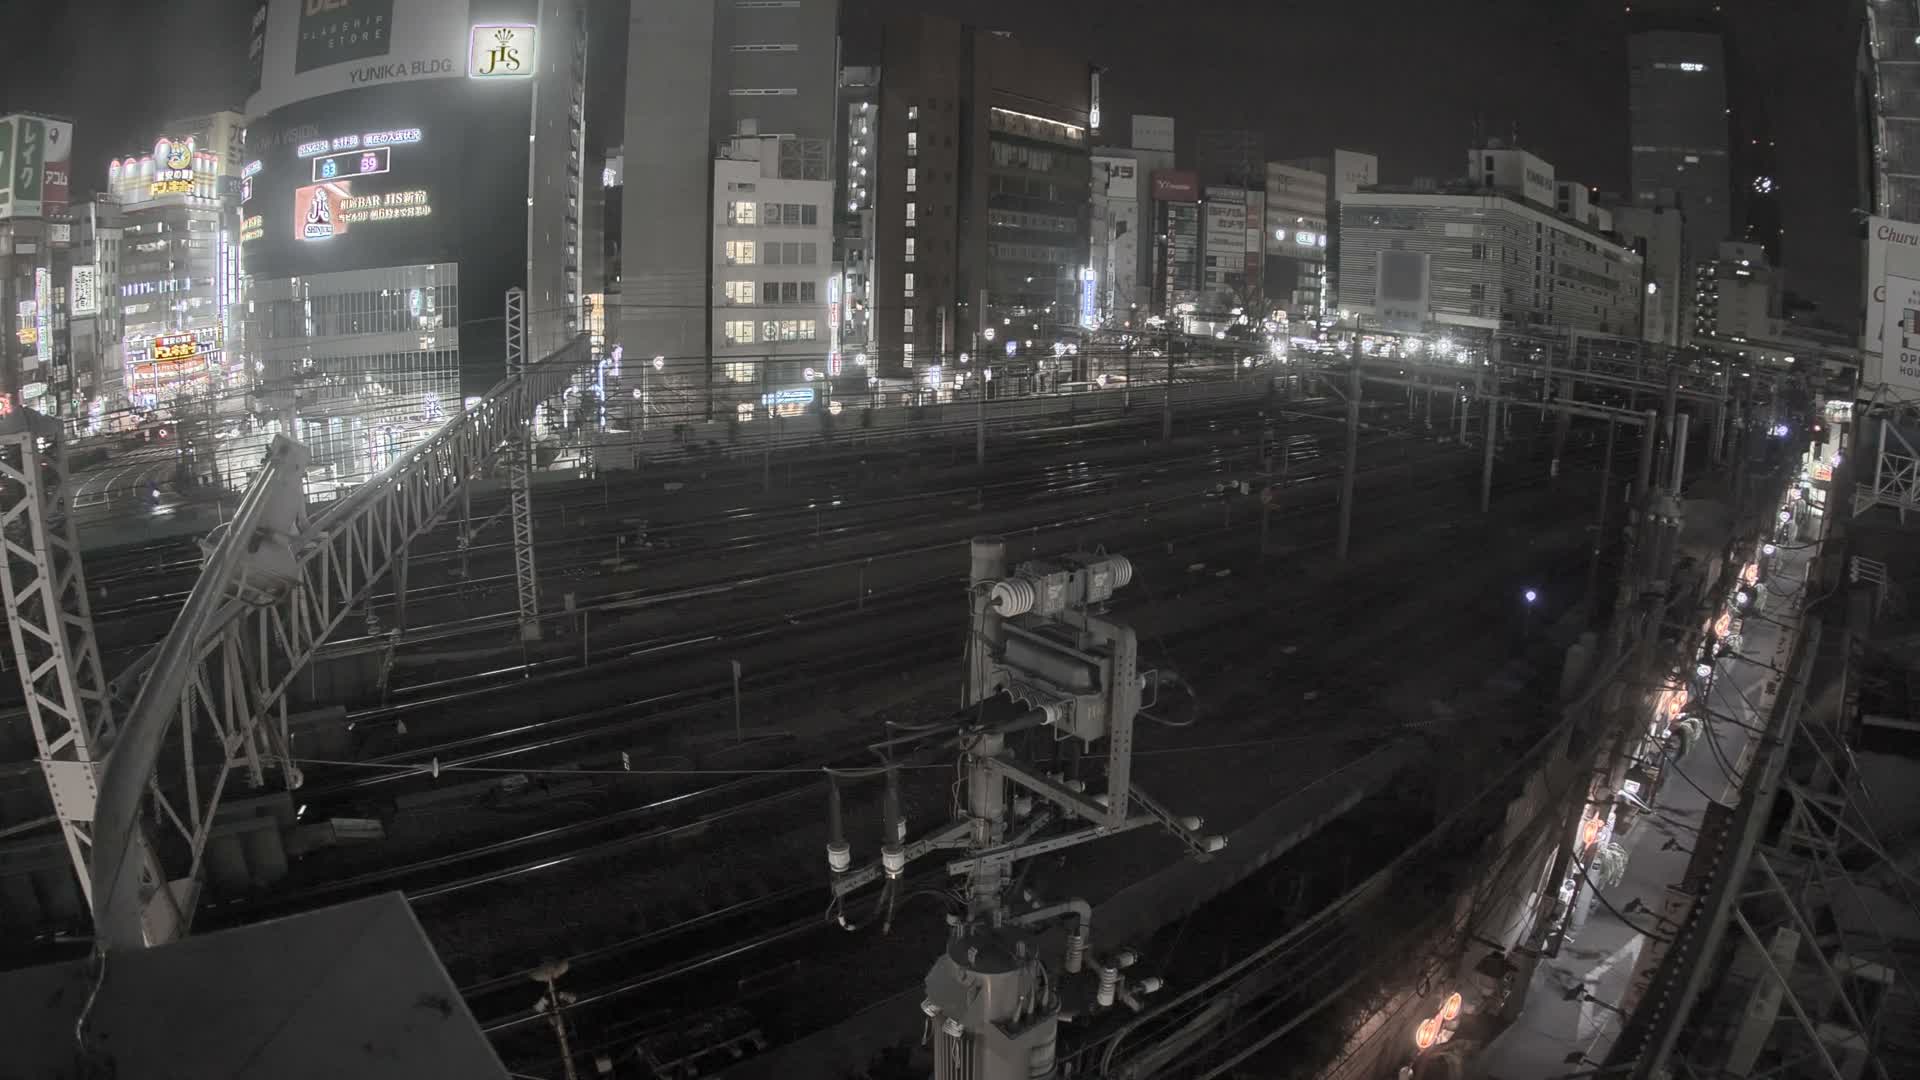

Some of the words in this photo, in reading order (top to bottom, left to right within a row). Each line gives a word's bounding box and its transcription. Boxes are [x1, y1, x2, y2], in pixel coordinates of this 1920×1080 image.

[479, 46, 520, 75] JIS
[350, 63, 408, 83] YUNIKA
[20, 121, 37, 190] レイク
[45, 170, 68, 186] アコム
